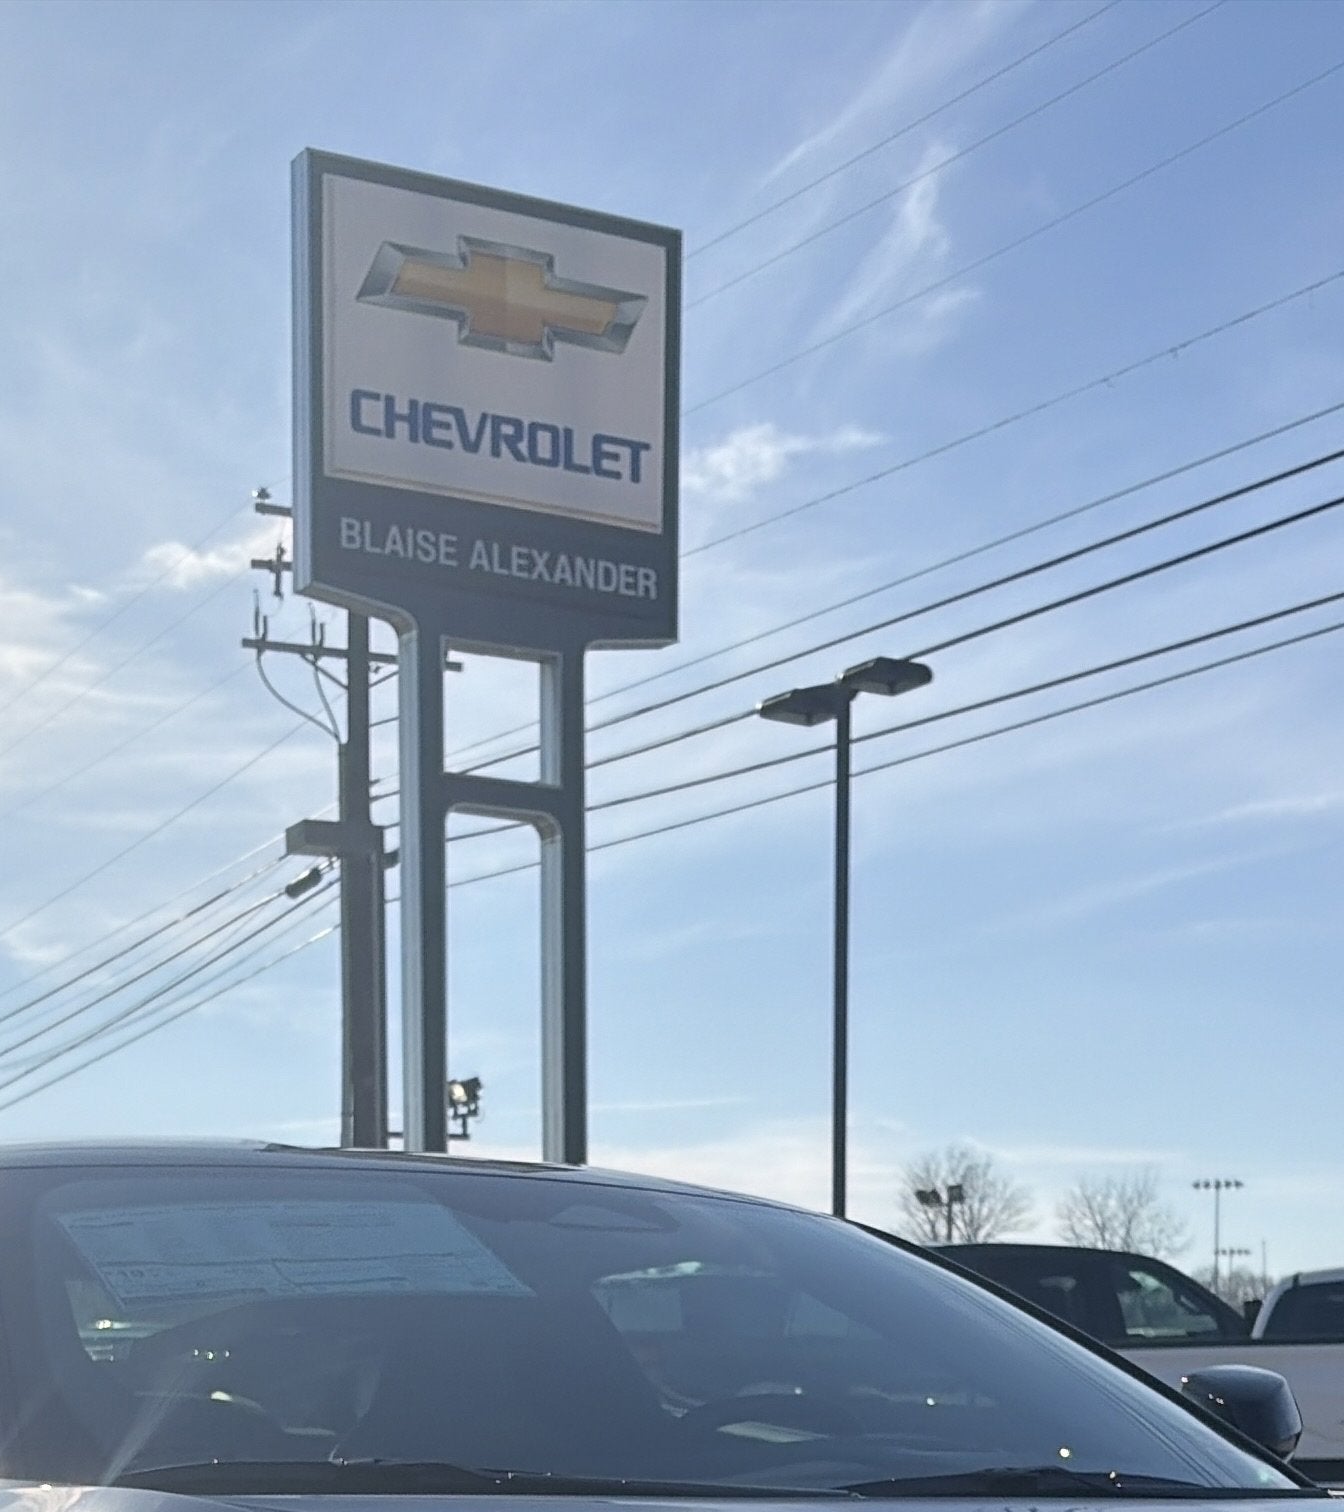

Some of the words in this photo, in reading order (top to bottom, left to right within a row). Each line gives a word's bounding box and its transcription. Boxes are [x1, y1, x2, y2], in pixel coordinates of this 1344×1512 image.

[350, 388, 651, 484] CHEVROLET
[341, 517, 457, 566] BLAISE
[470, 540, 656, 600] ALEXANDER
